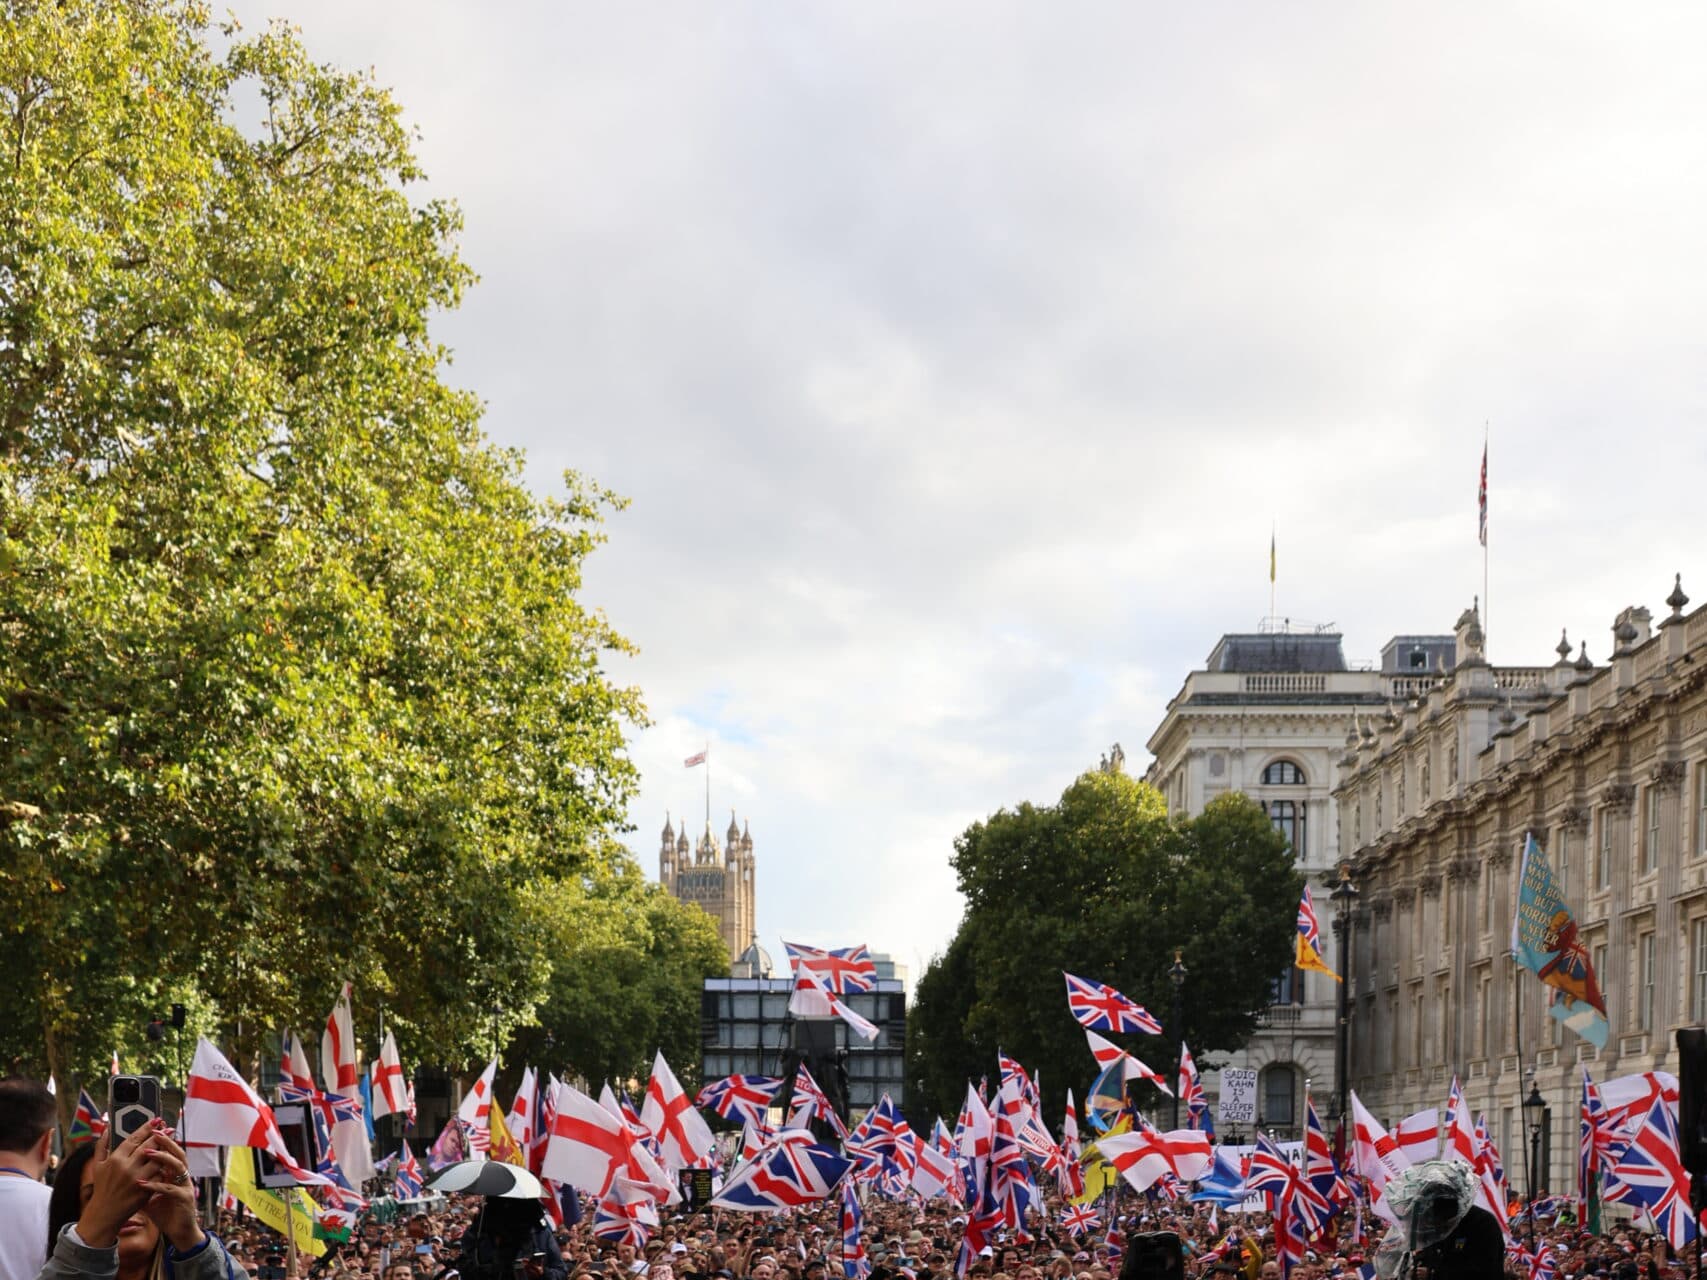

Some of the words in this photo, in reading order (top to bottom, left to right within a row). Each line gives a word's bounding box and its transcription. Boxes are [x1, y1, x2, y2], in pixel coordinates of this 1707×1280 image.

[1534, 895, 1557, 912] BUT
[1527, 923, 1560, 945] NEVER
[1534, 940, 1549, 953] US
[1227, 1080, 1254, 1088] KAHN
[1232, 1088, 1245, 1096] IS
[1219, 1103, 1254, 1112] SLEEPER
[1224, 1111, 1253, 1120] AGENT
